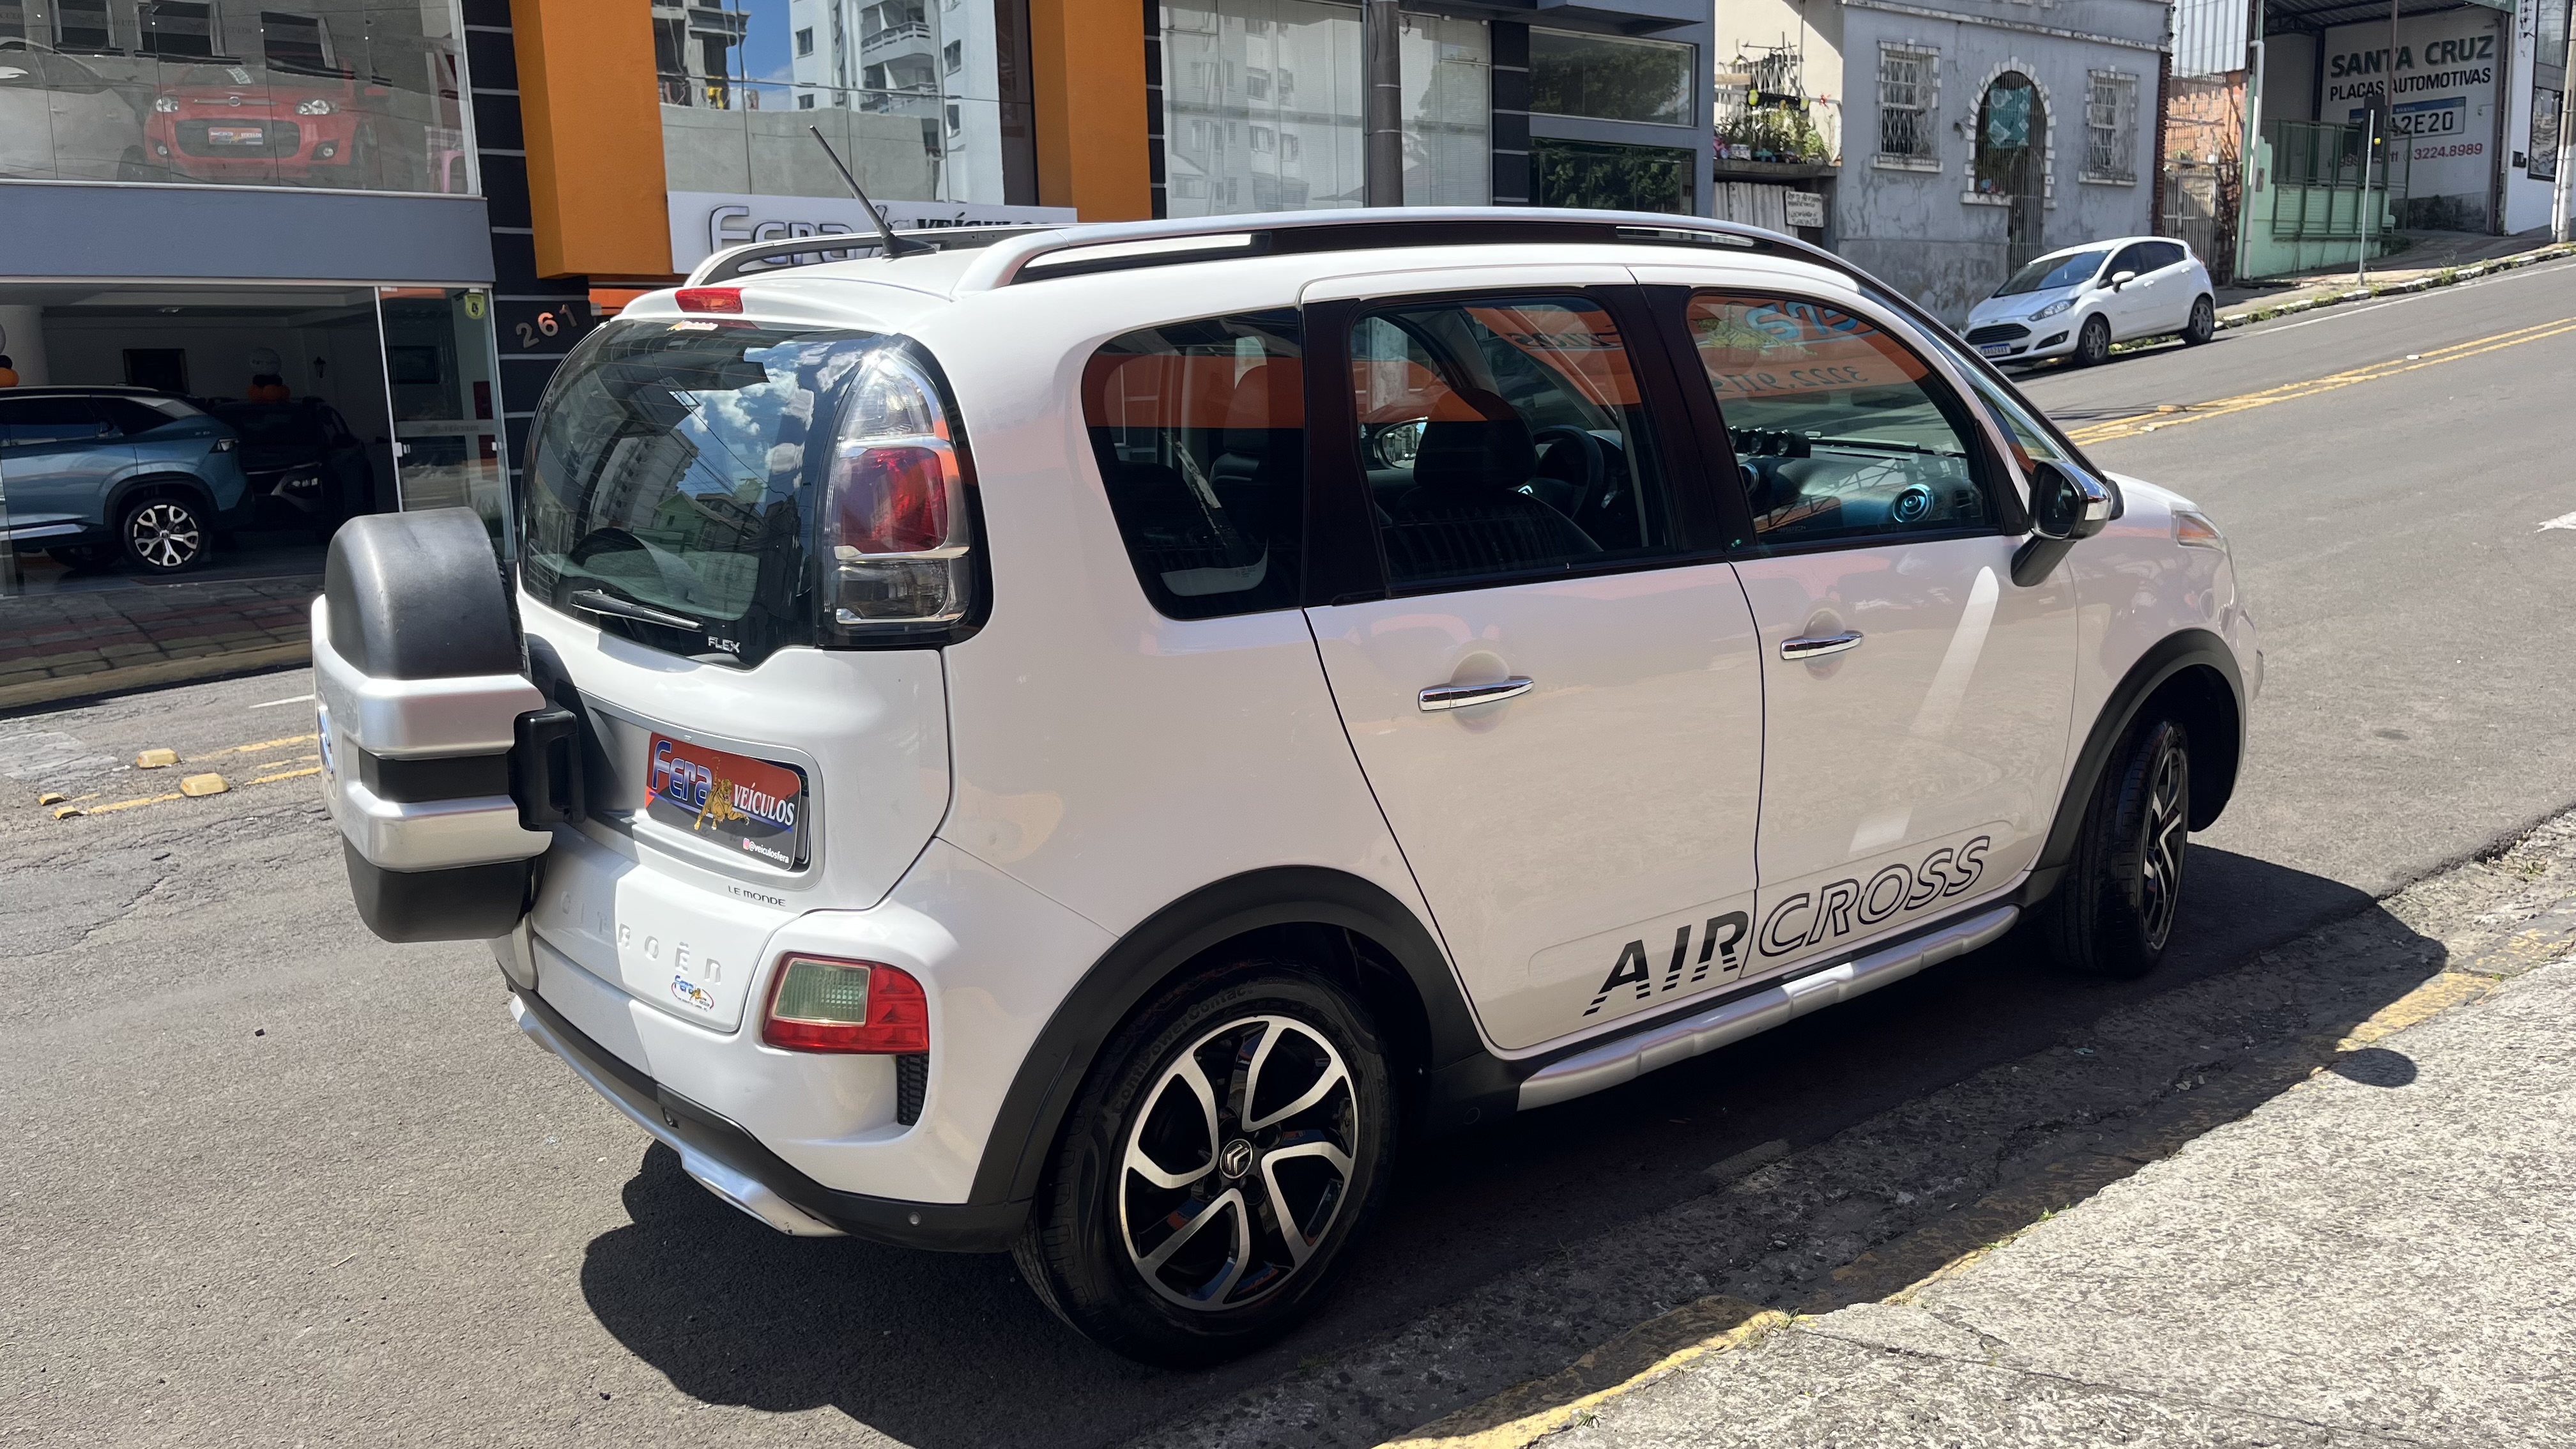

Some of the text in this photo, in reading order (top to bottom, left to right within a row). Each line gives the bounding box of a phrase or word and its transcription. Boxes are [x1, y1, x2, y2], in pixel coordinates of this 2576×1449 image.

[2330, 35, 2495, 78] SANTA CRUZ
[2330, 67, 2490, 102] PLACAS AUTOMOTIVAS
[2414, 142, 2483, 160] 3224.8989
[516, 303, 578, 348] 261
[708, 636, 740, 653] FLEX
[734, 782, 795, 826] VEÍCULOS
[749, 841, 789, 864] @veiculosfera
[728, 885, 741, 896] LE
